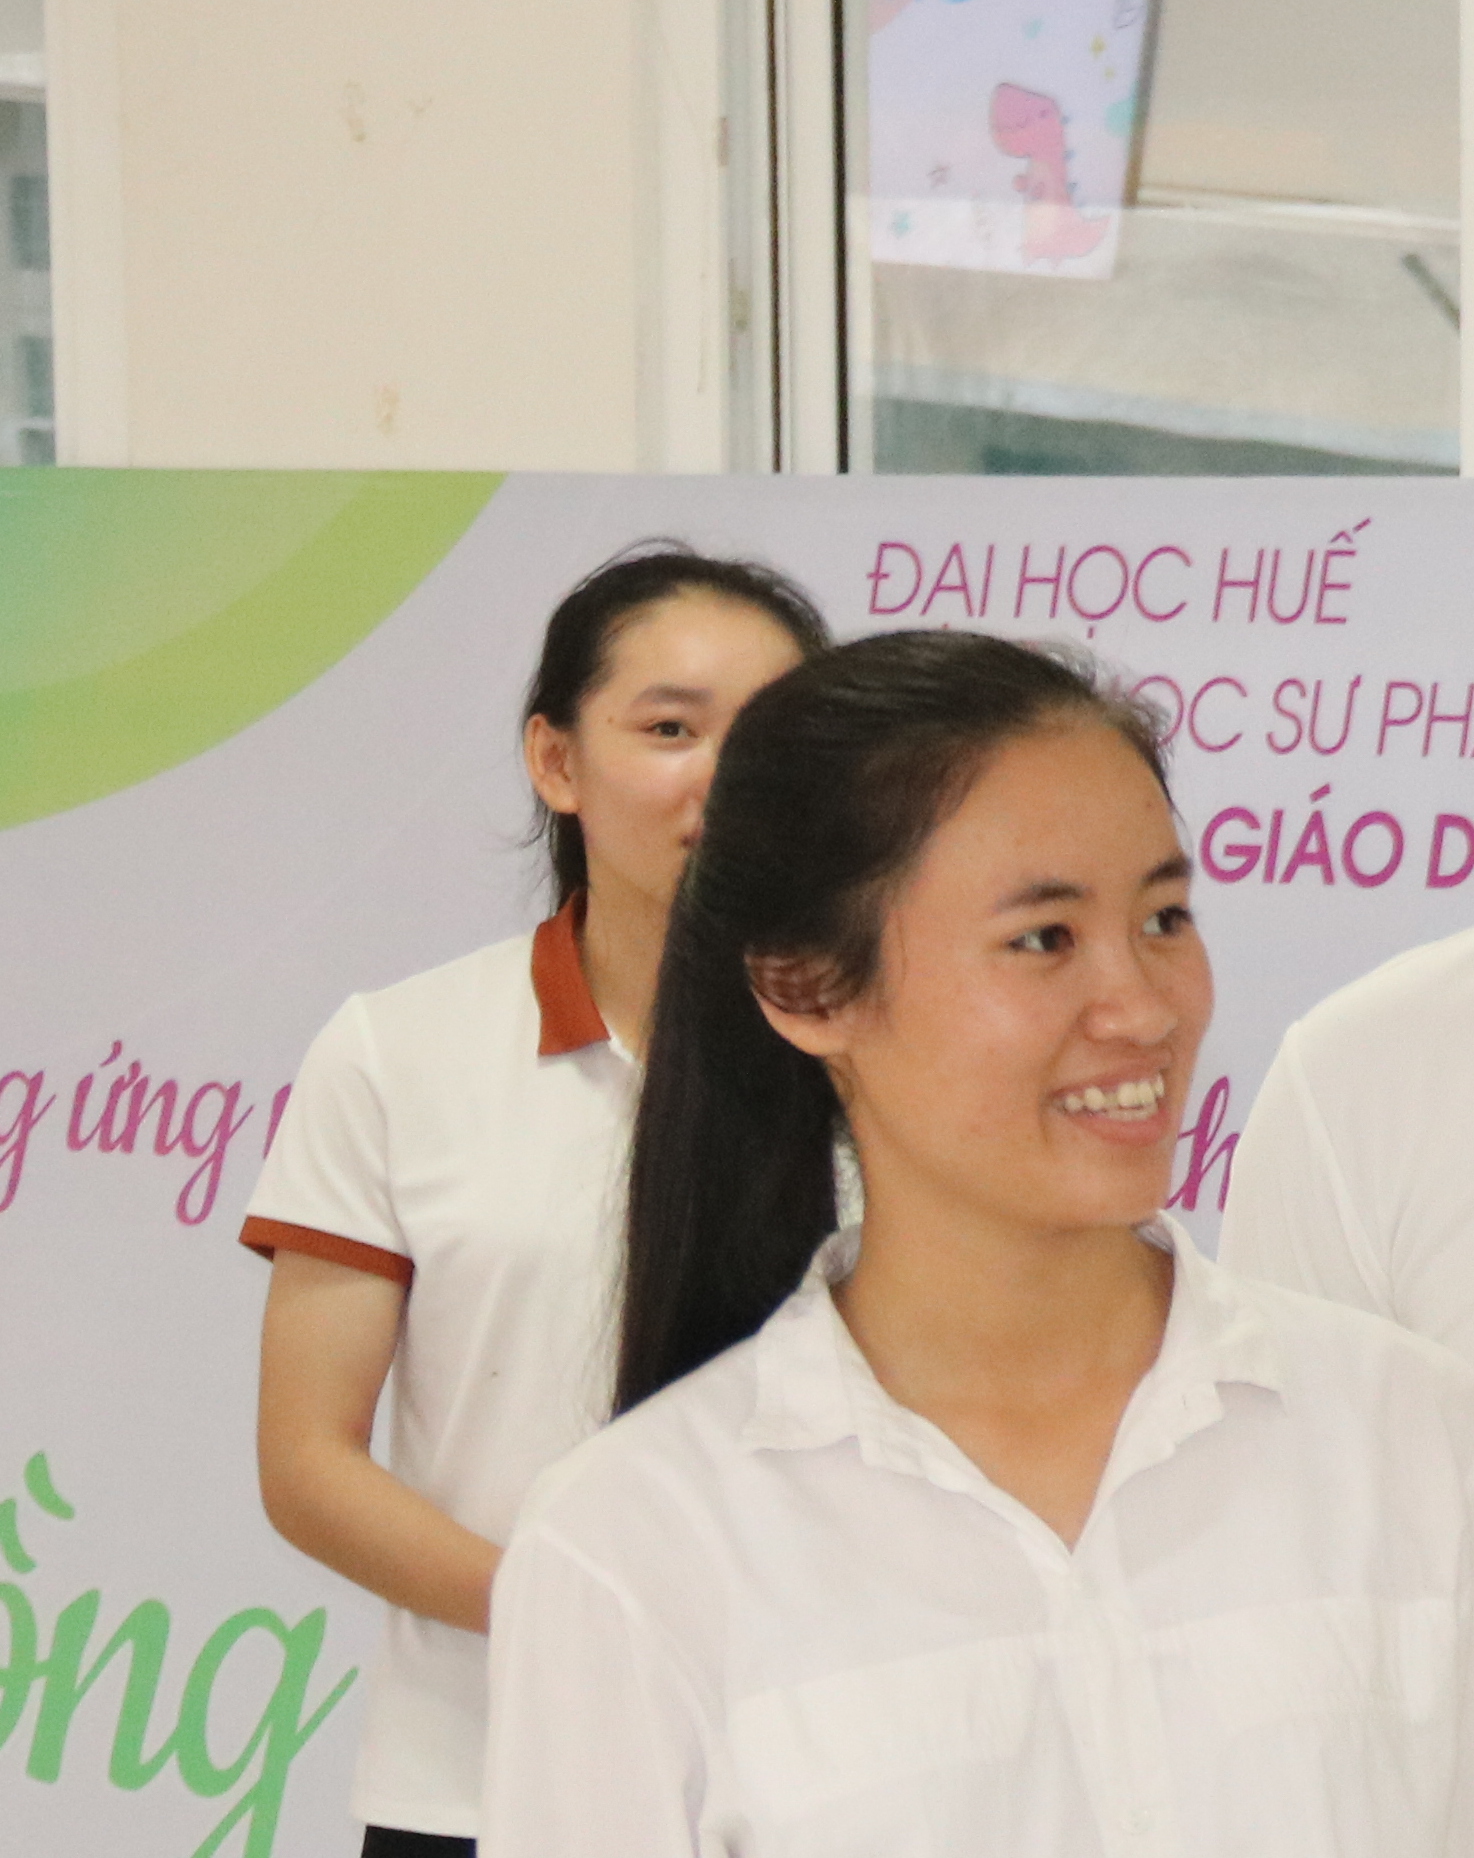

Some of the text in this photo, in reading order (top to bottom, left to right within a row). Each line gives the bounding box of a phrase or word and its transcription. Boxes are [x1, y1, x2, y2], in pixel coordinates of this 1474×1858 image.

[866, 516, 1374, 638] ĐẠI HỌC HUẾ
[1265, 674, 1363, 756] SƯ
[1199, 783, 1405, 890] GIÁO
[66, 1038, 255, 1228] ứng
